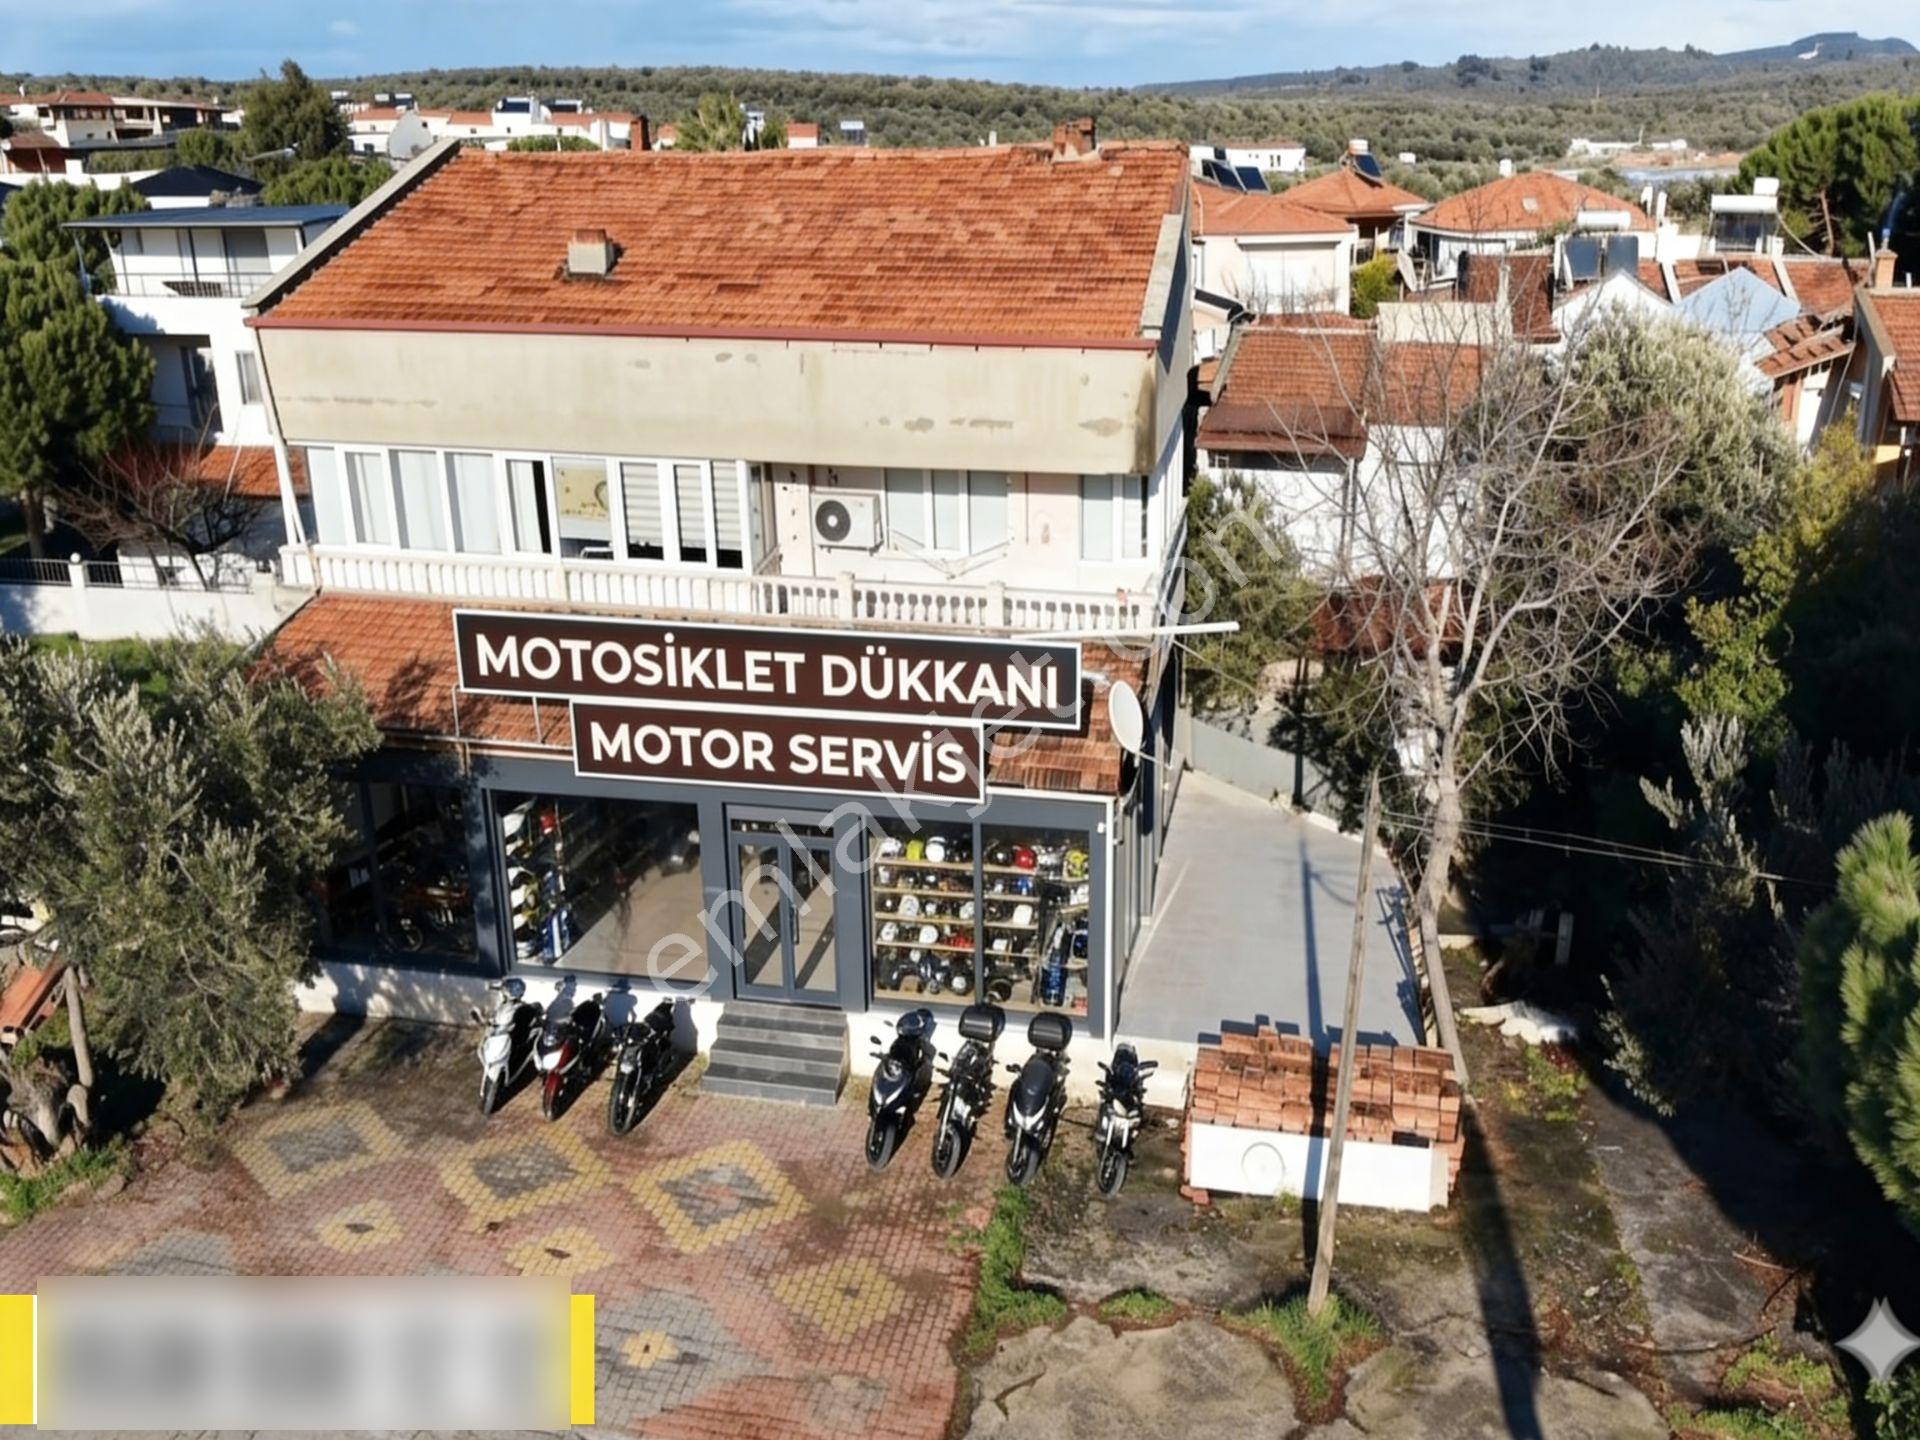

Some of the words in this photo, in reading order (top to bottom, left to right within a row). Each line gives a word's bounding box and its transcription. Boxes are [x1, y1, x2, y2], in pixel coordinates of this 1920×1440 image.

[475, 633, 805, 695] MOTOSİKLET
[822, 646, 1058, 710] DÜKKANI
[590, 722, 775, 772] MOTOR
[789, 730, 968, 784] SERVİS
